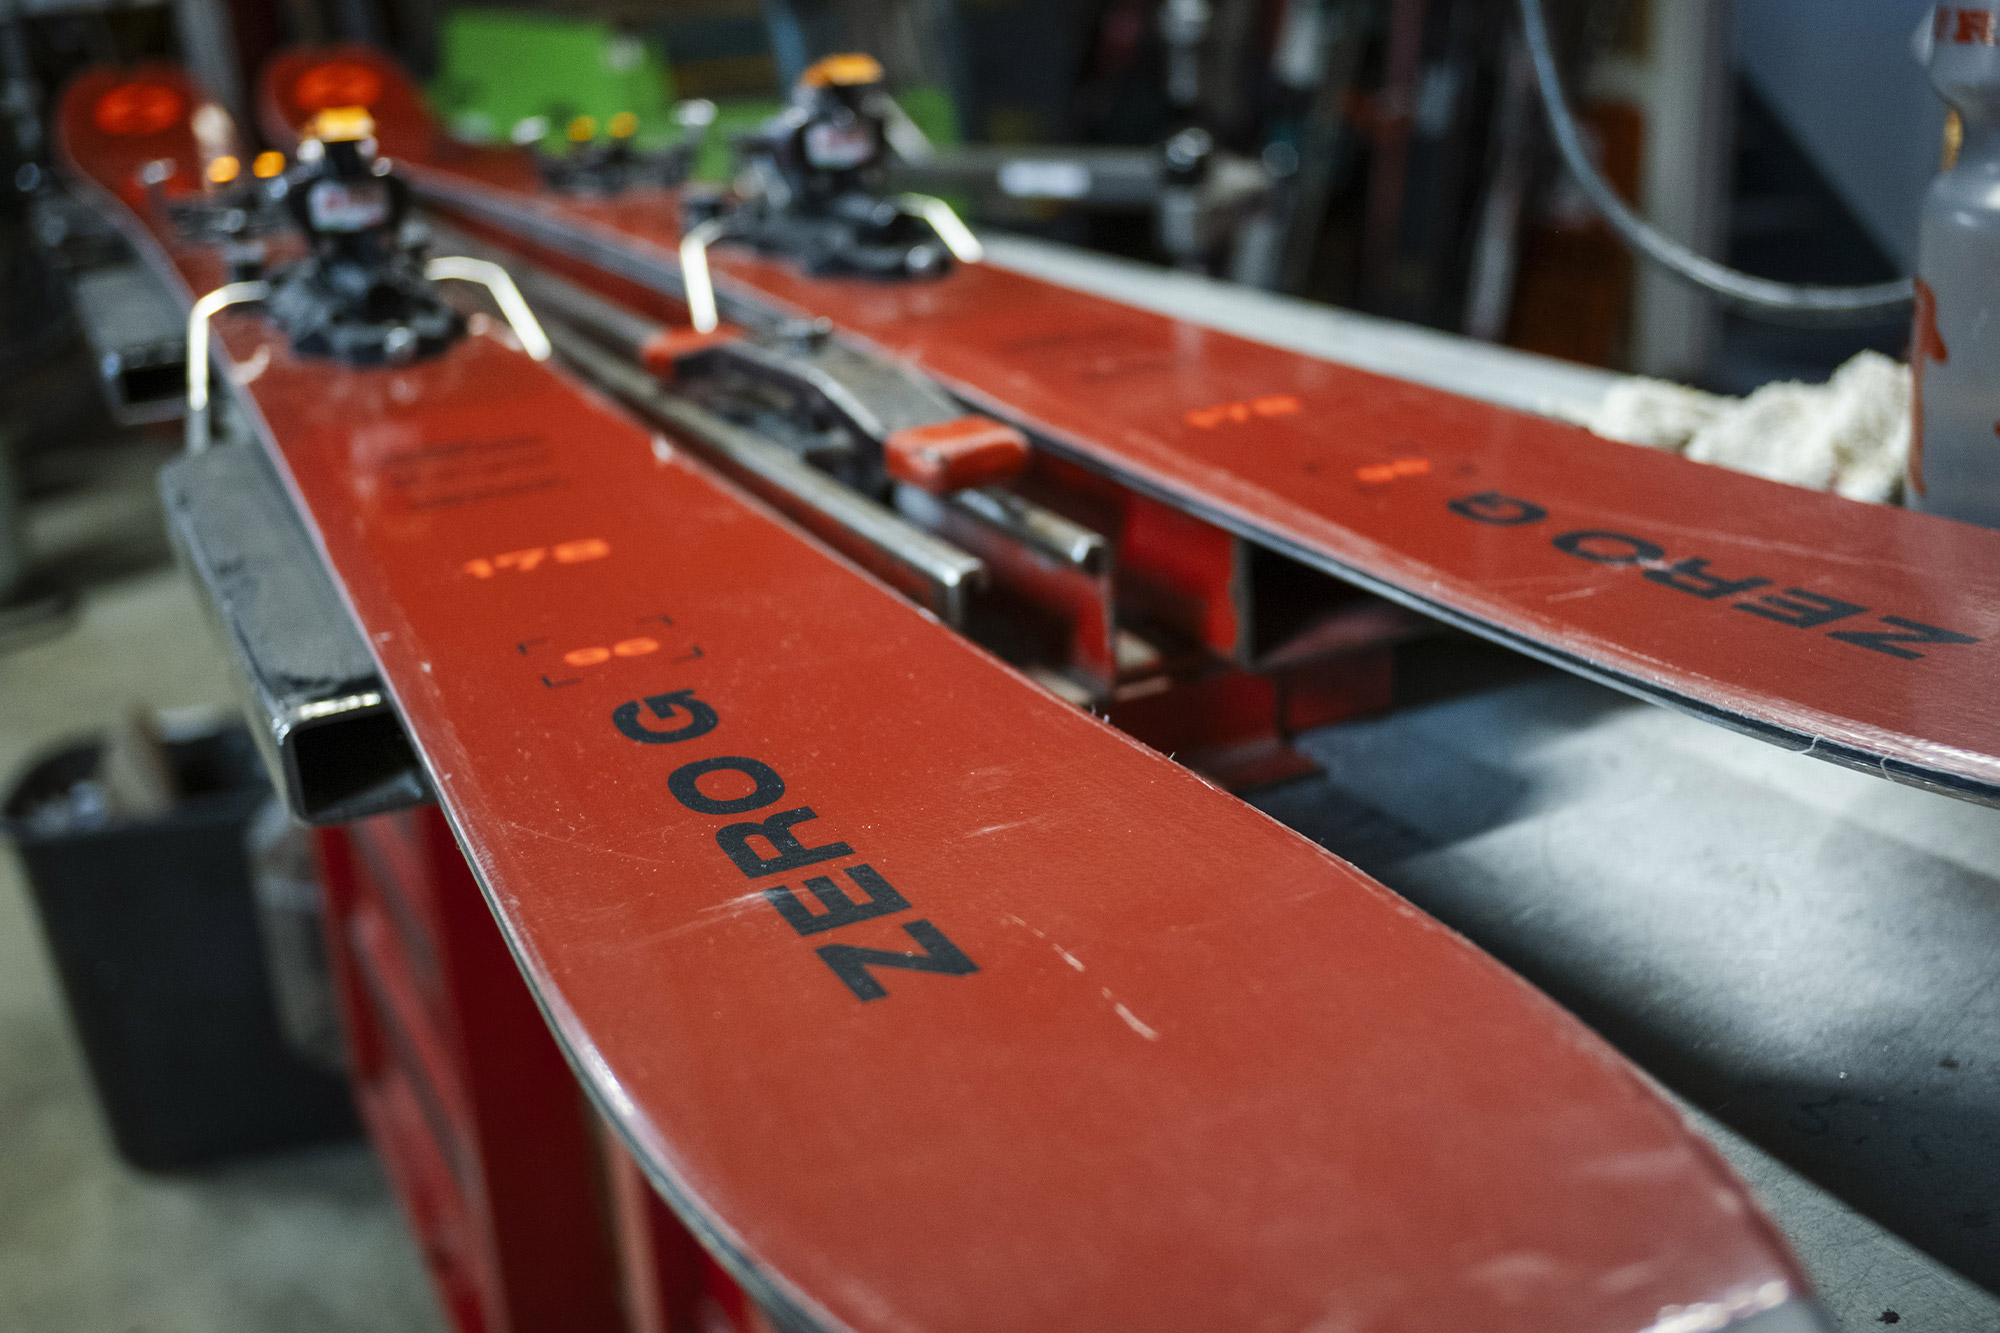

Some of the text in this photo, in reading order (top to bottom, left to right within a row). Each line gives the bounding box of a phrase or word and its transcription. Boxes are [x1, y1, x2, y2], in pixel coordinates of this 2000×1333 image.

[1446, 490, 1983, 662] ZERO G
[611, 688, 982, 1003] ZERO G
